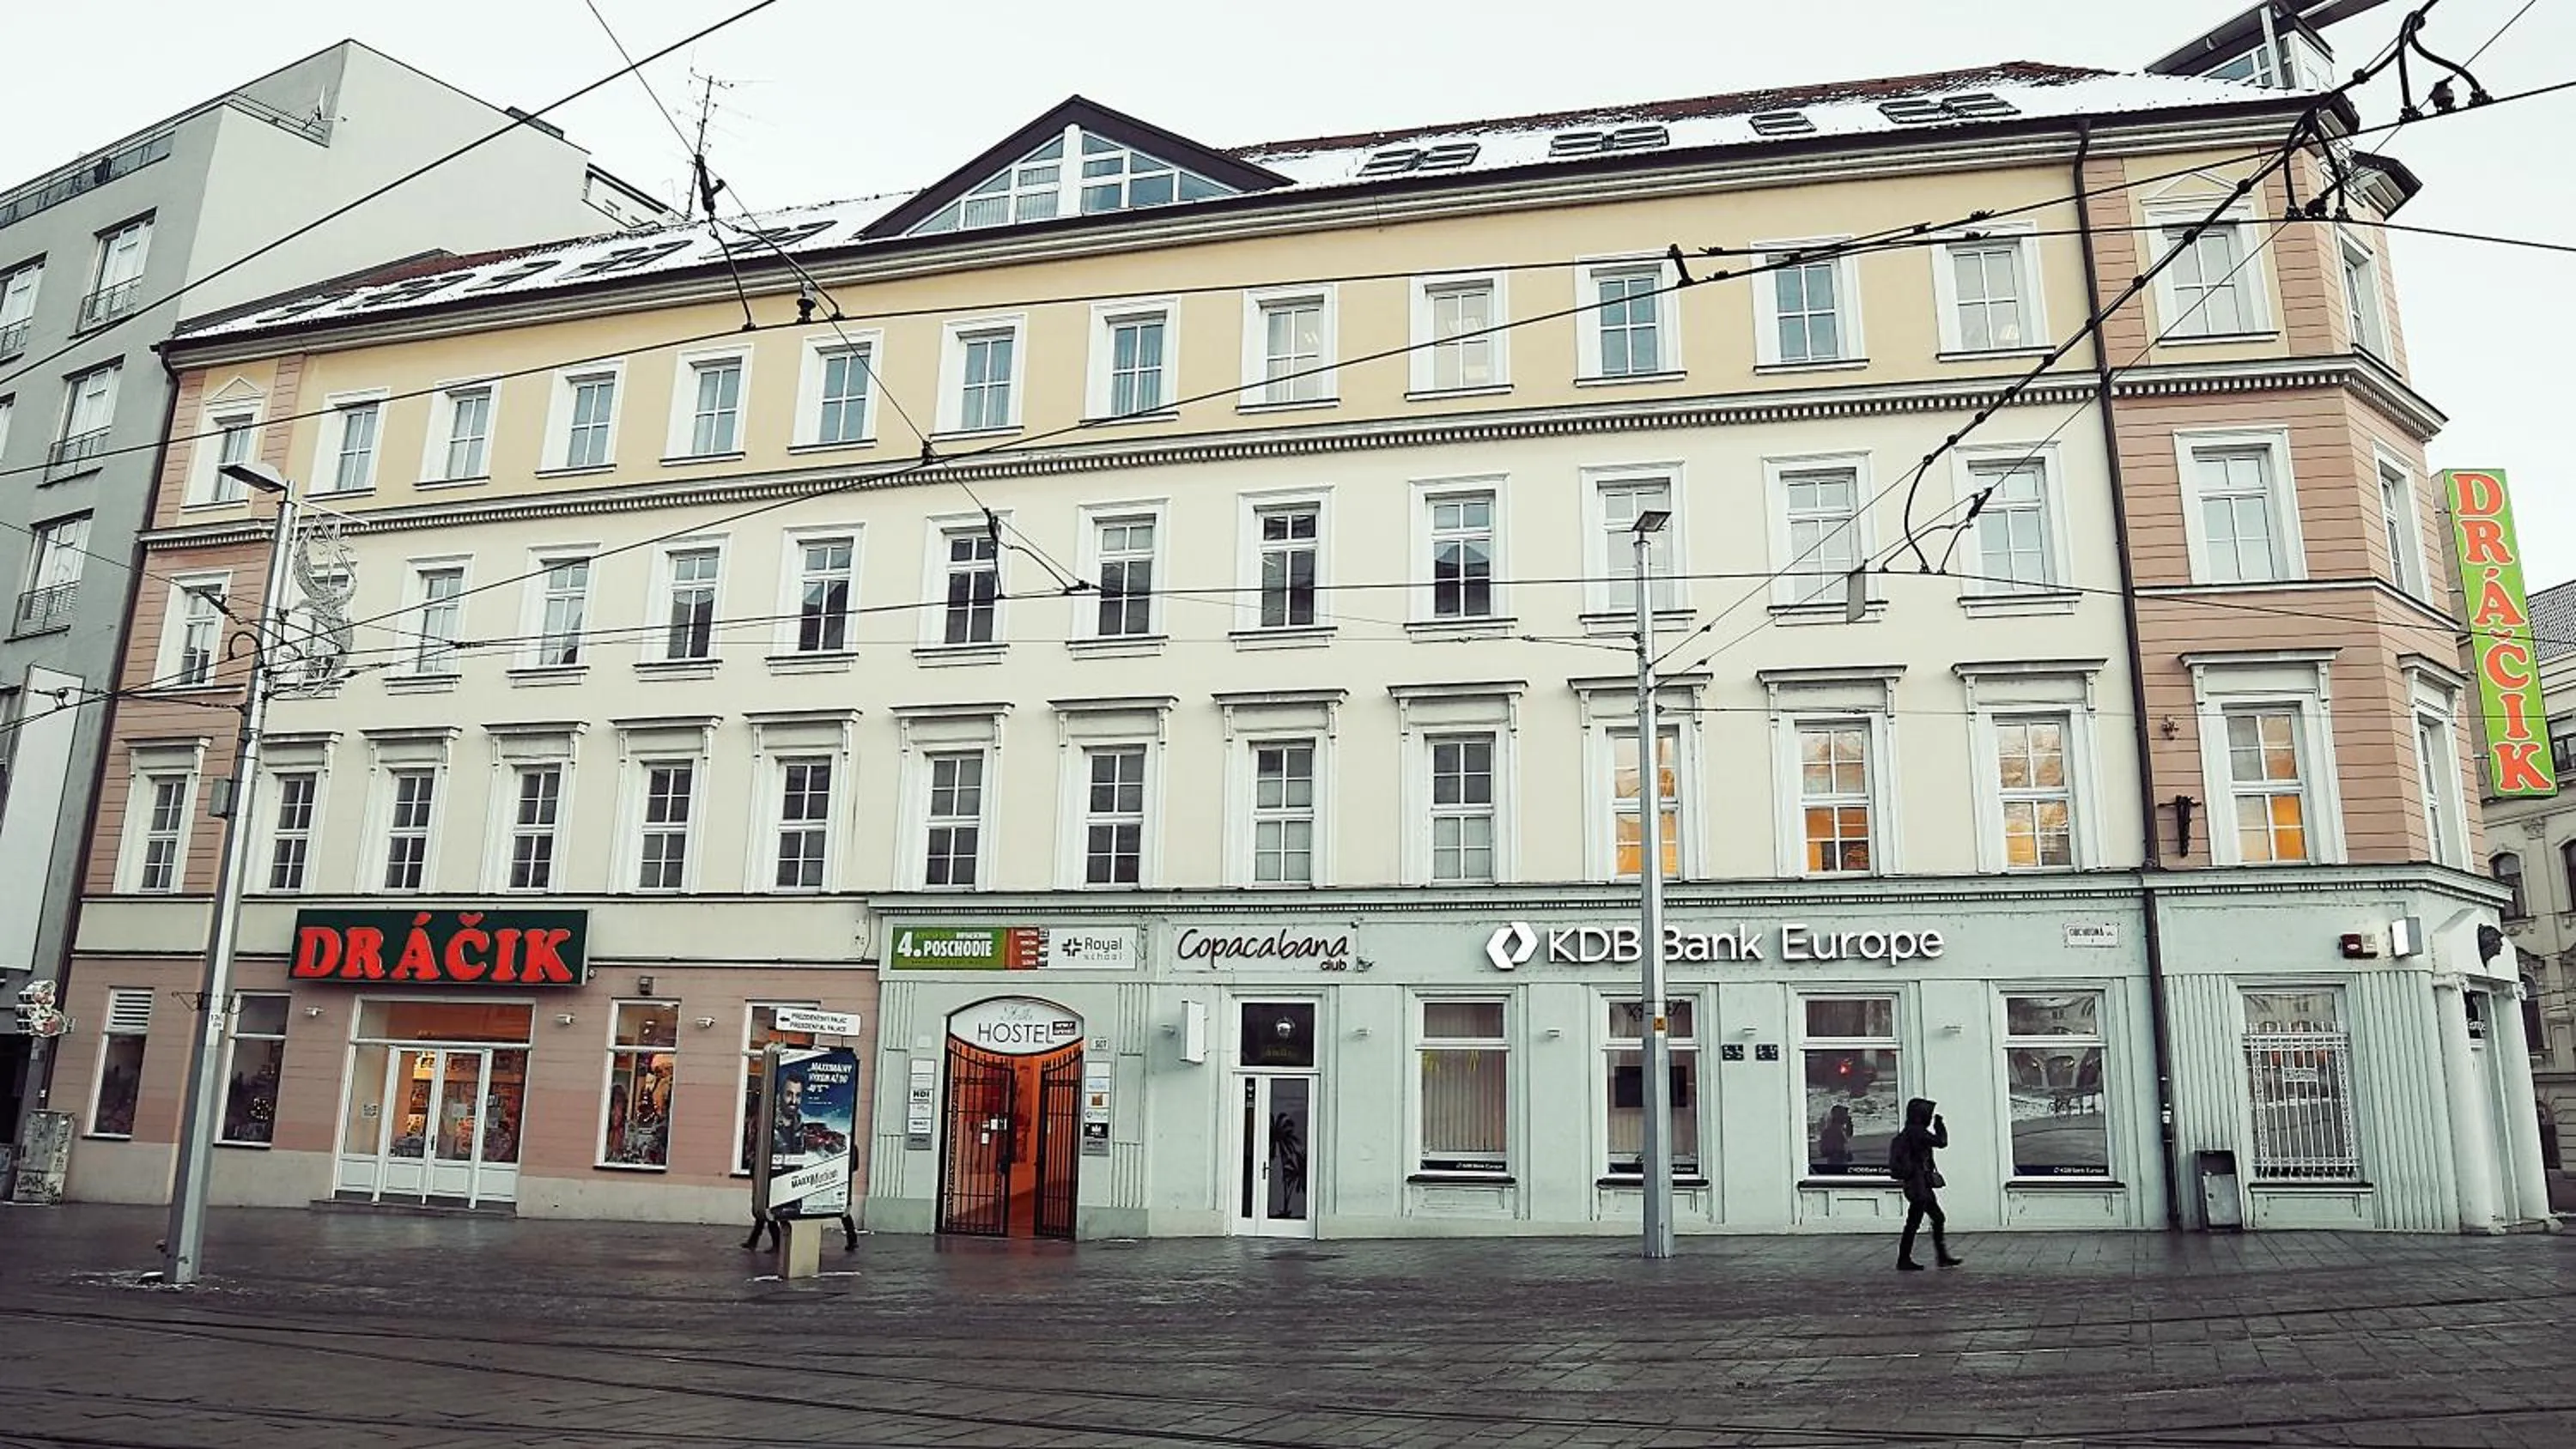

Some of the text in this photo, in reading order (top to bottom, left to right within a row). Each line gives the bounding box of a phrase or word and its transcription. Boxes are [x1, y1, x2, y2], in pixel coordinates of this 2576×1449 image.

[2452, 473, 2552, 791] DRÁČIK
[294, 911, 573, 983] DRÁČIK
[923, 940, 993, 957] POSCHODIE
[1084, 937, 1122, 954] Royal
[1177, 928, 1349, 969] Copacabana
[1548, 923, 1945, 966] KDB Bank Europe
[1320, 959, 1347, 971] club
[977, 1022, 1055, 1045] HOSTEL
